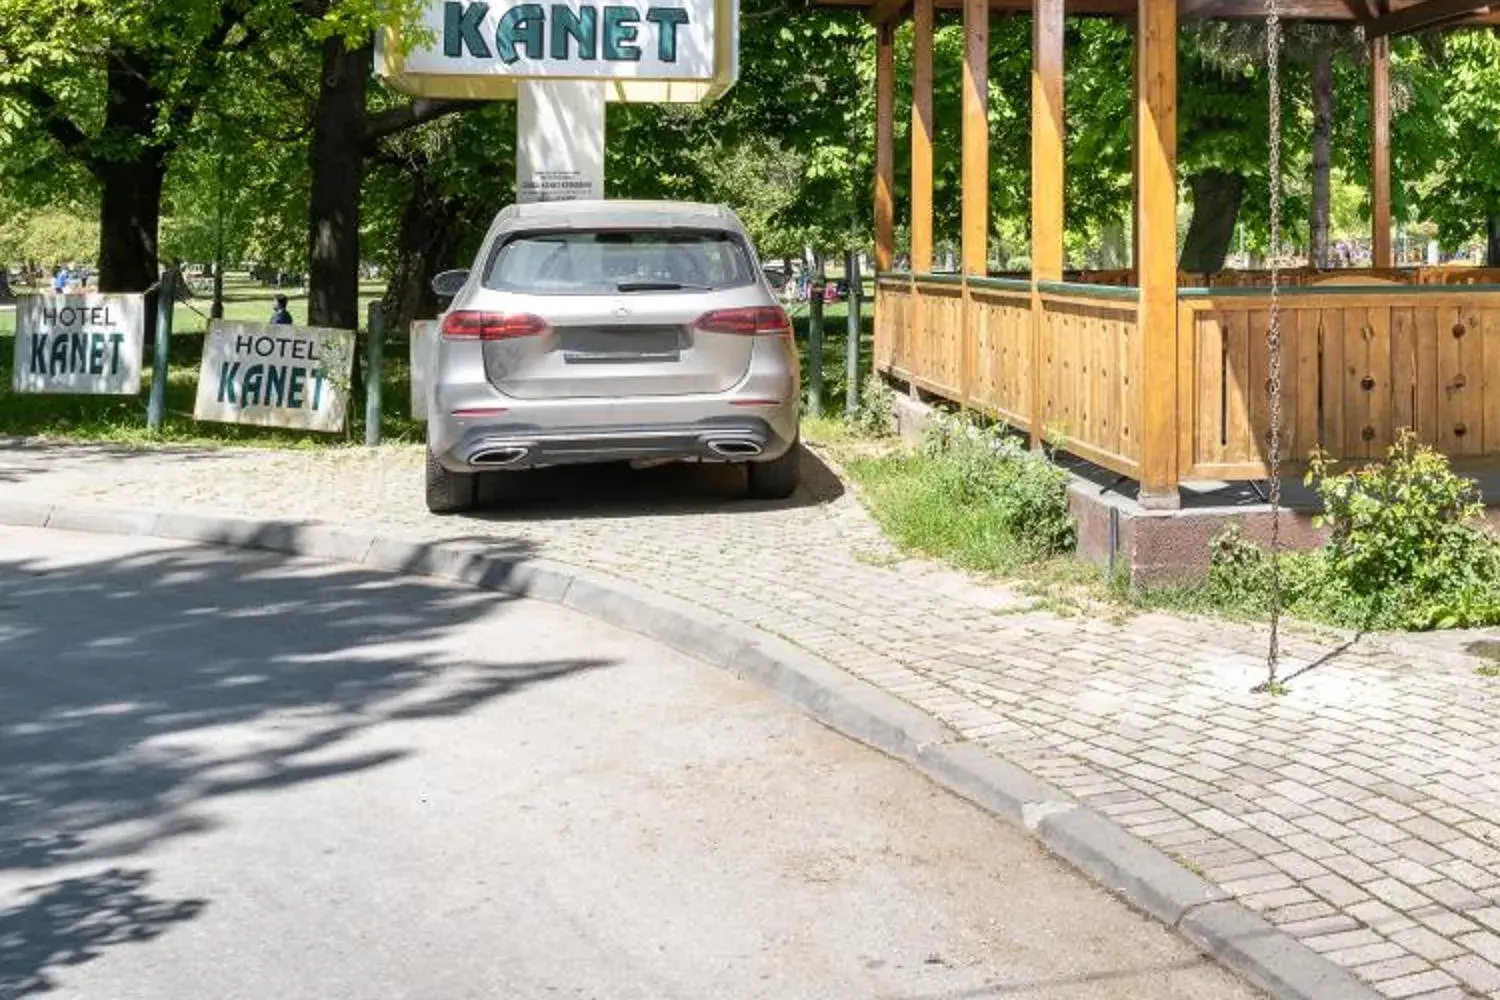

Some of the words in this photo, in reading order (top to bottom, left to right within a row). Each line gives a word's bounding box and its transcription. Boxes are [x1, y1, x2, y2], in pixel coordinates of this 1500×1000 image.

[443, 1, 689, 65] KANET
[43, 306, 116, 327] HOTEL
[30, 332, 125, 377] KANET
[235, 335, 321, 361] HOTEL
[217, 361, 329, 411] KANET
